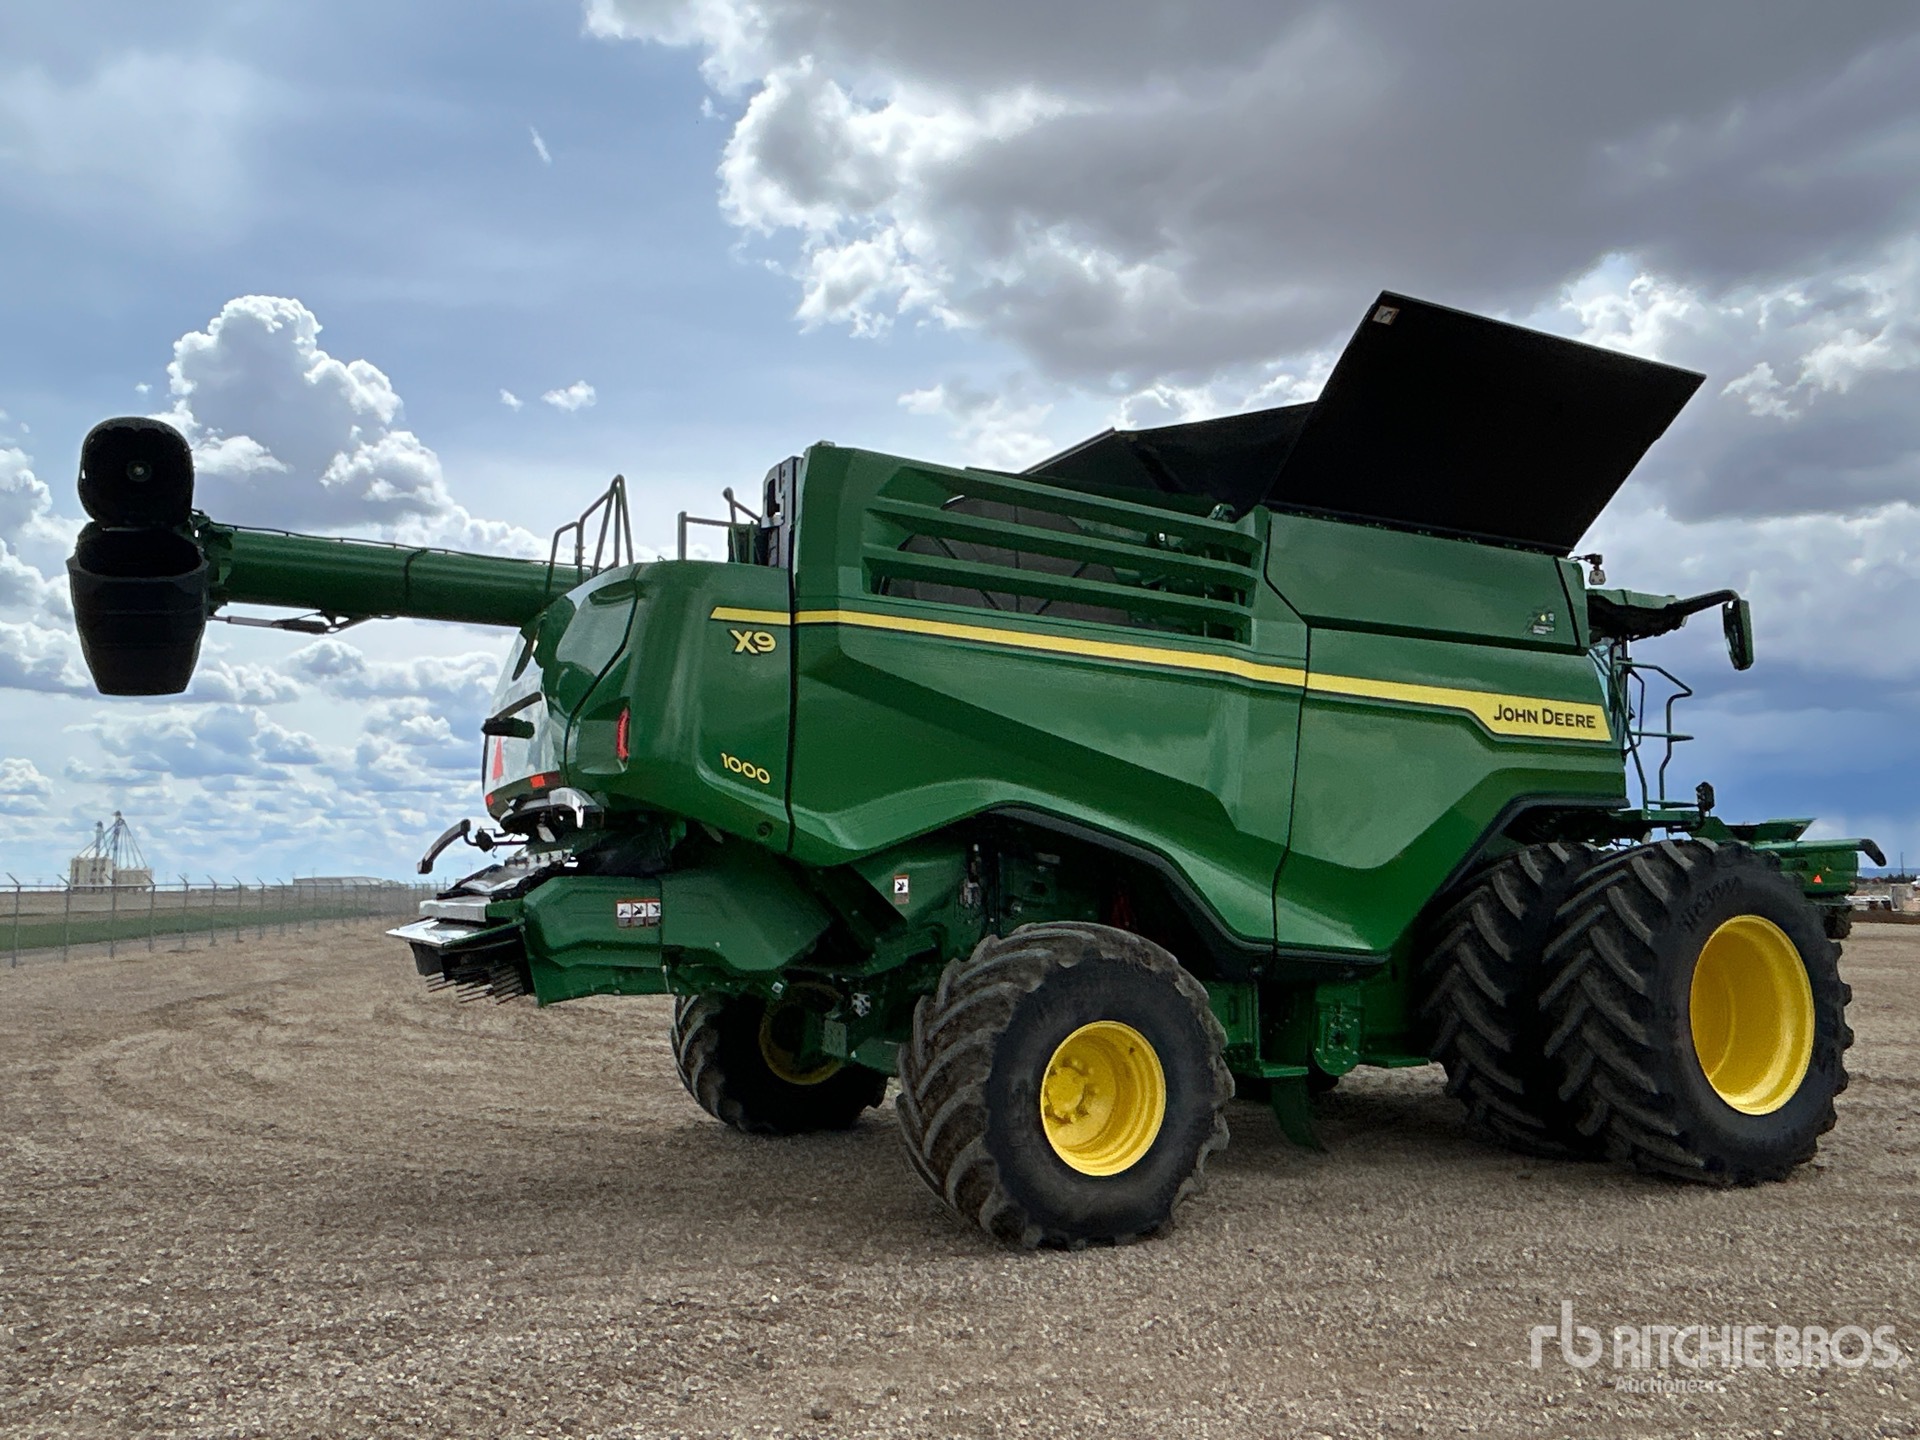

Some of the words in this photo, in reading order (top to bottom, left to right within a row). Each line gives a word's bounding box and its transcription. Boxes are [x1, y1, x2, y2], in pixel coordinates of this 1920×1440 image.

[730, 629, 777, 654] X9
[1494, 704, 1538, 725] JOHN
[1542, 708, 1596, 729] DEERE
[721, 752, 771, 784] 1000
